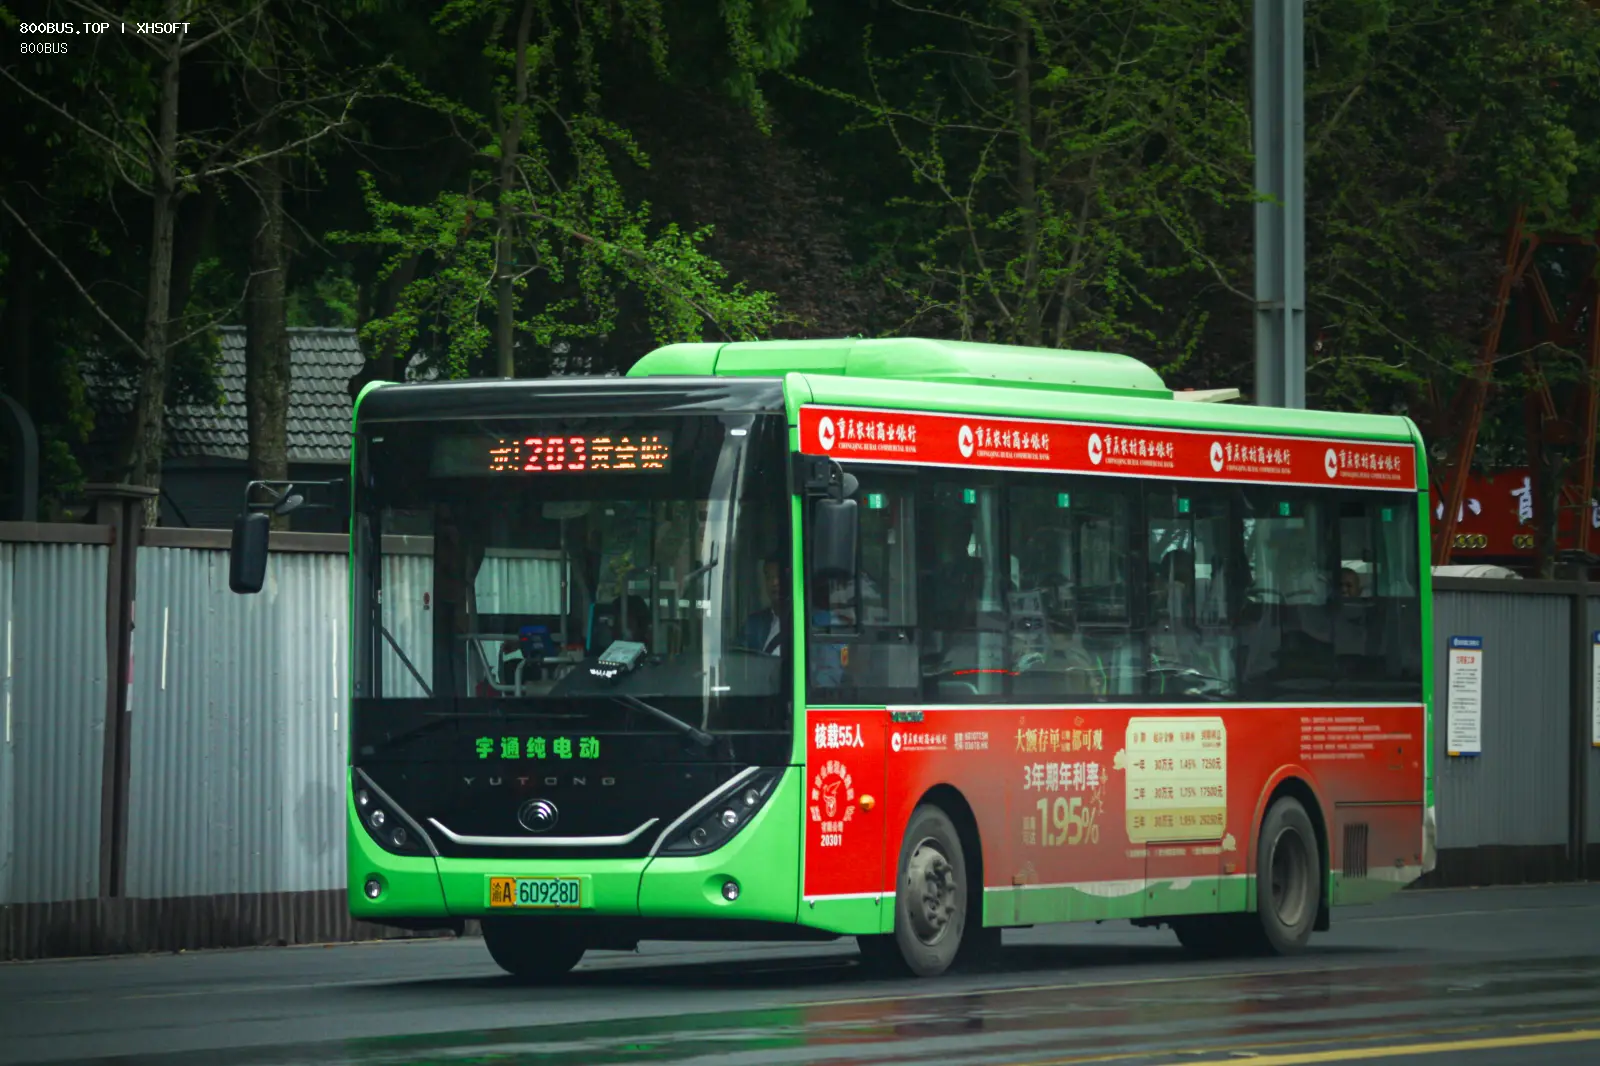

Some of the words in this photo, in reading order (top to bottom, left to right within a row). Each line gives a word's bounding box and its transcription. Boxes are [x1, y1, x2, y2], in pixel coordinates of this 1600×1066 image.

[814, 722, 865, 749] 核载55人
[475, 736, 600, 759] 宇通纯电动
[463, 776, 616, 786] YUTONG
[1023, 760, 1100, 792] 3年期年利率
[1036, 796, 1099, 847] 1.95%
[820, 834, 842, 847] 20301
[519, 882, 579, 904] 60928D
